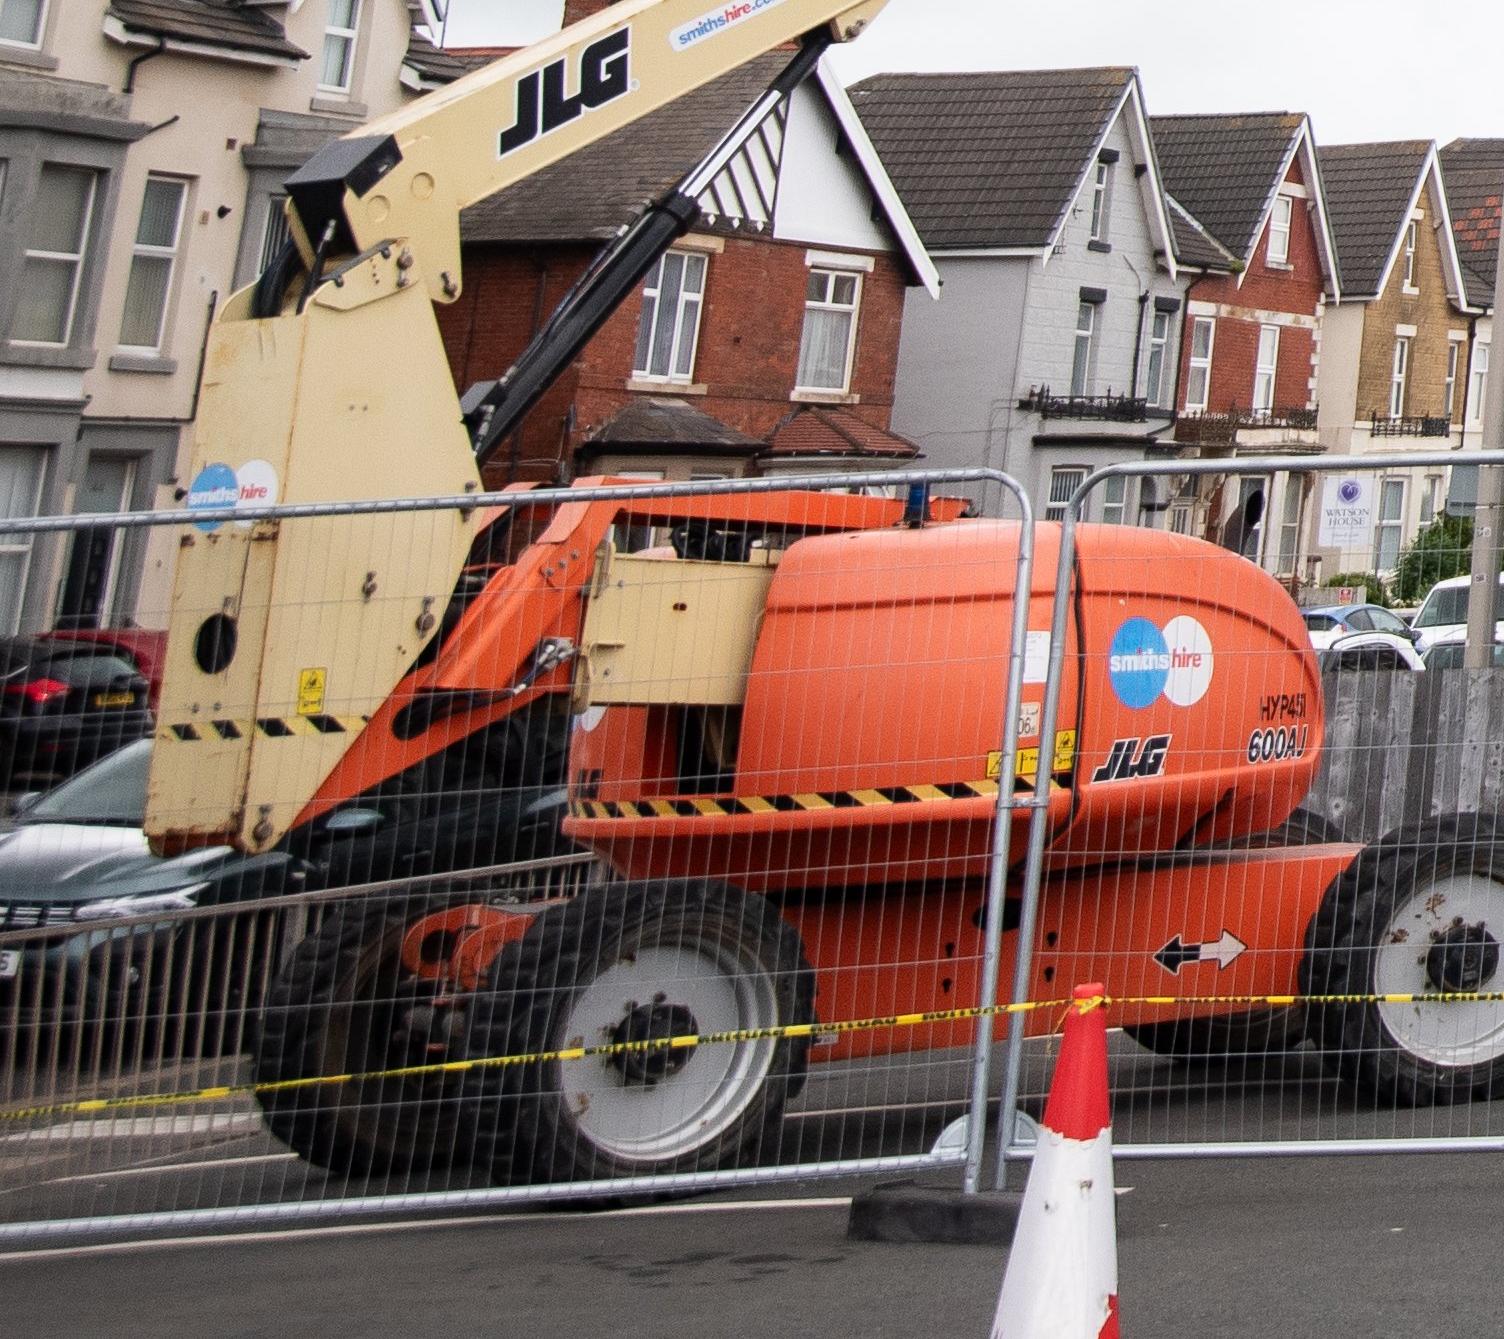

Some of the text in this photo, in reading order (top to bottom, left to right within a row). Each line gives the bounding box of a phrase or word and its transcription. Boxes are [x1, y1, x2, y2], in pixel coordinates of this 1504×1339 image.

[499, 25, 630, 157] JLG
[240, 484, 268, 499] hire
[1326, 508, 1369, 516] WATSON
[1328, 517, 1365, 526] HOUSE
[1110, 647, 1202, 672] smiths hire
[1247, 724, 1308, 763] 600AJ
[1091, 734, 1172, 784] JLG
